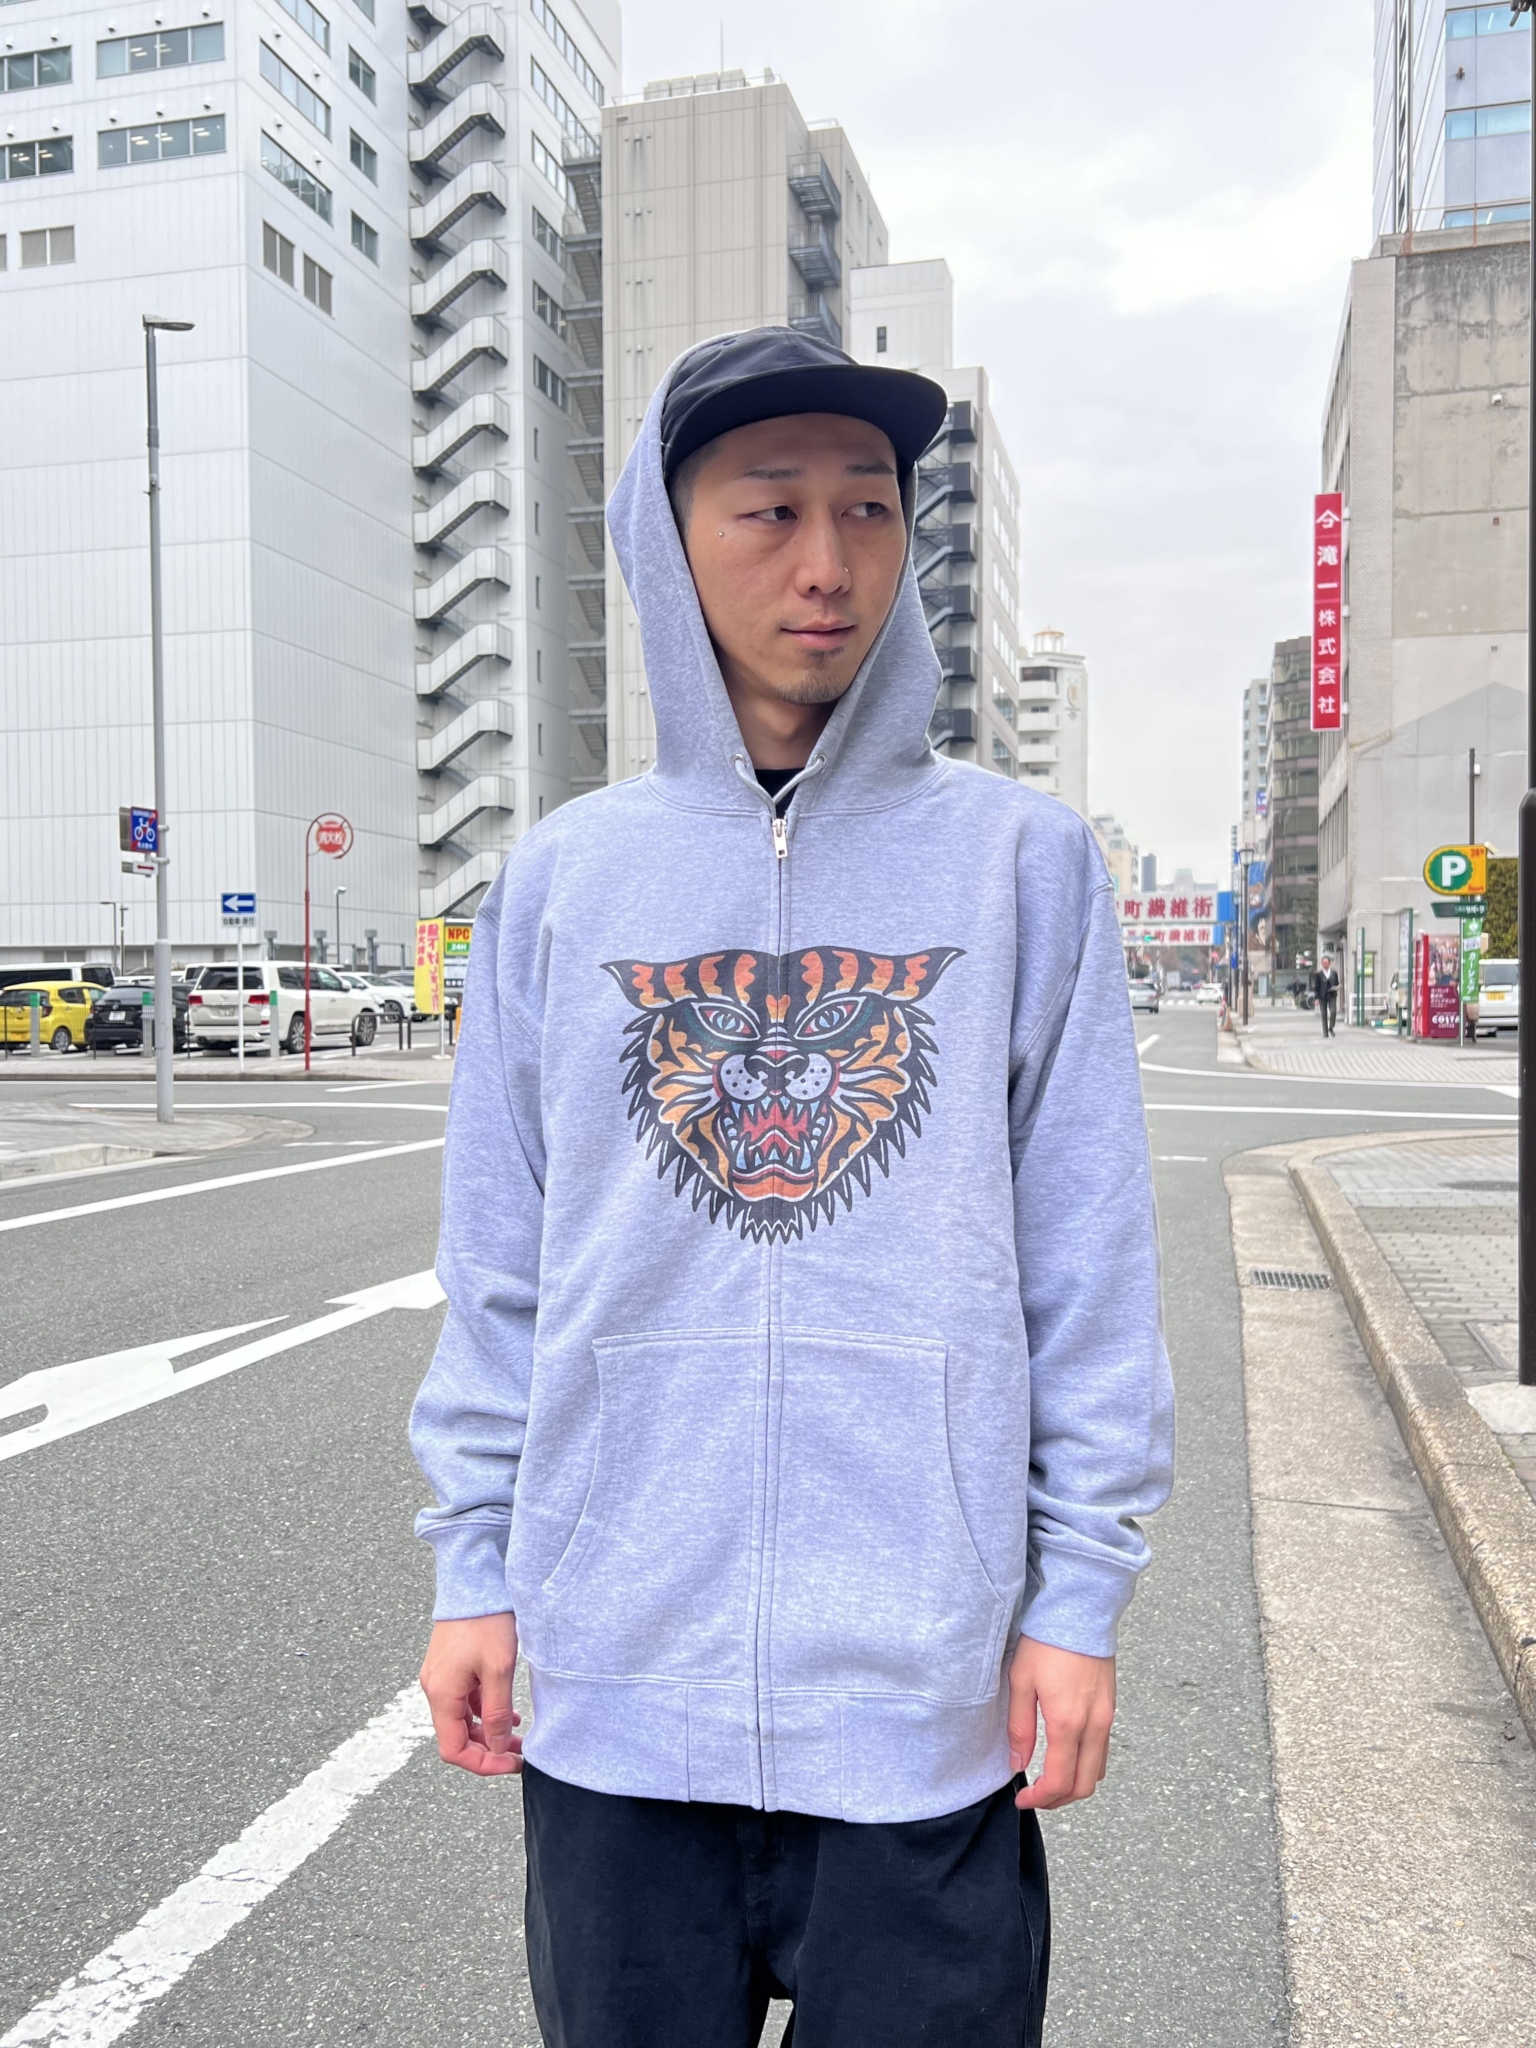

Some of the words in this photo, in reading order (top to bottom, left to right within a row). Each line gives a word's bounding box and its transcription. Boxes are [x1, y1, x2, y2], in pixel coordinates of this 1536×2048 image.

[1442, 855, 1467, 887] P
[448, 928, 470, 940] NPC
[451, 943, 467, 951] 24H
